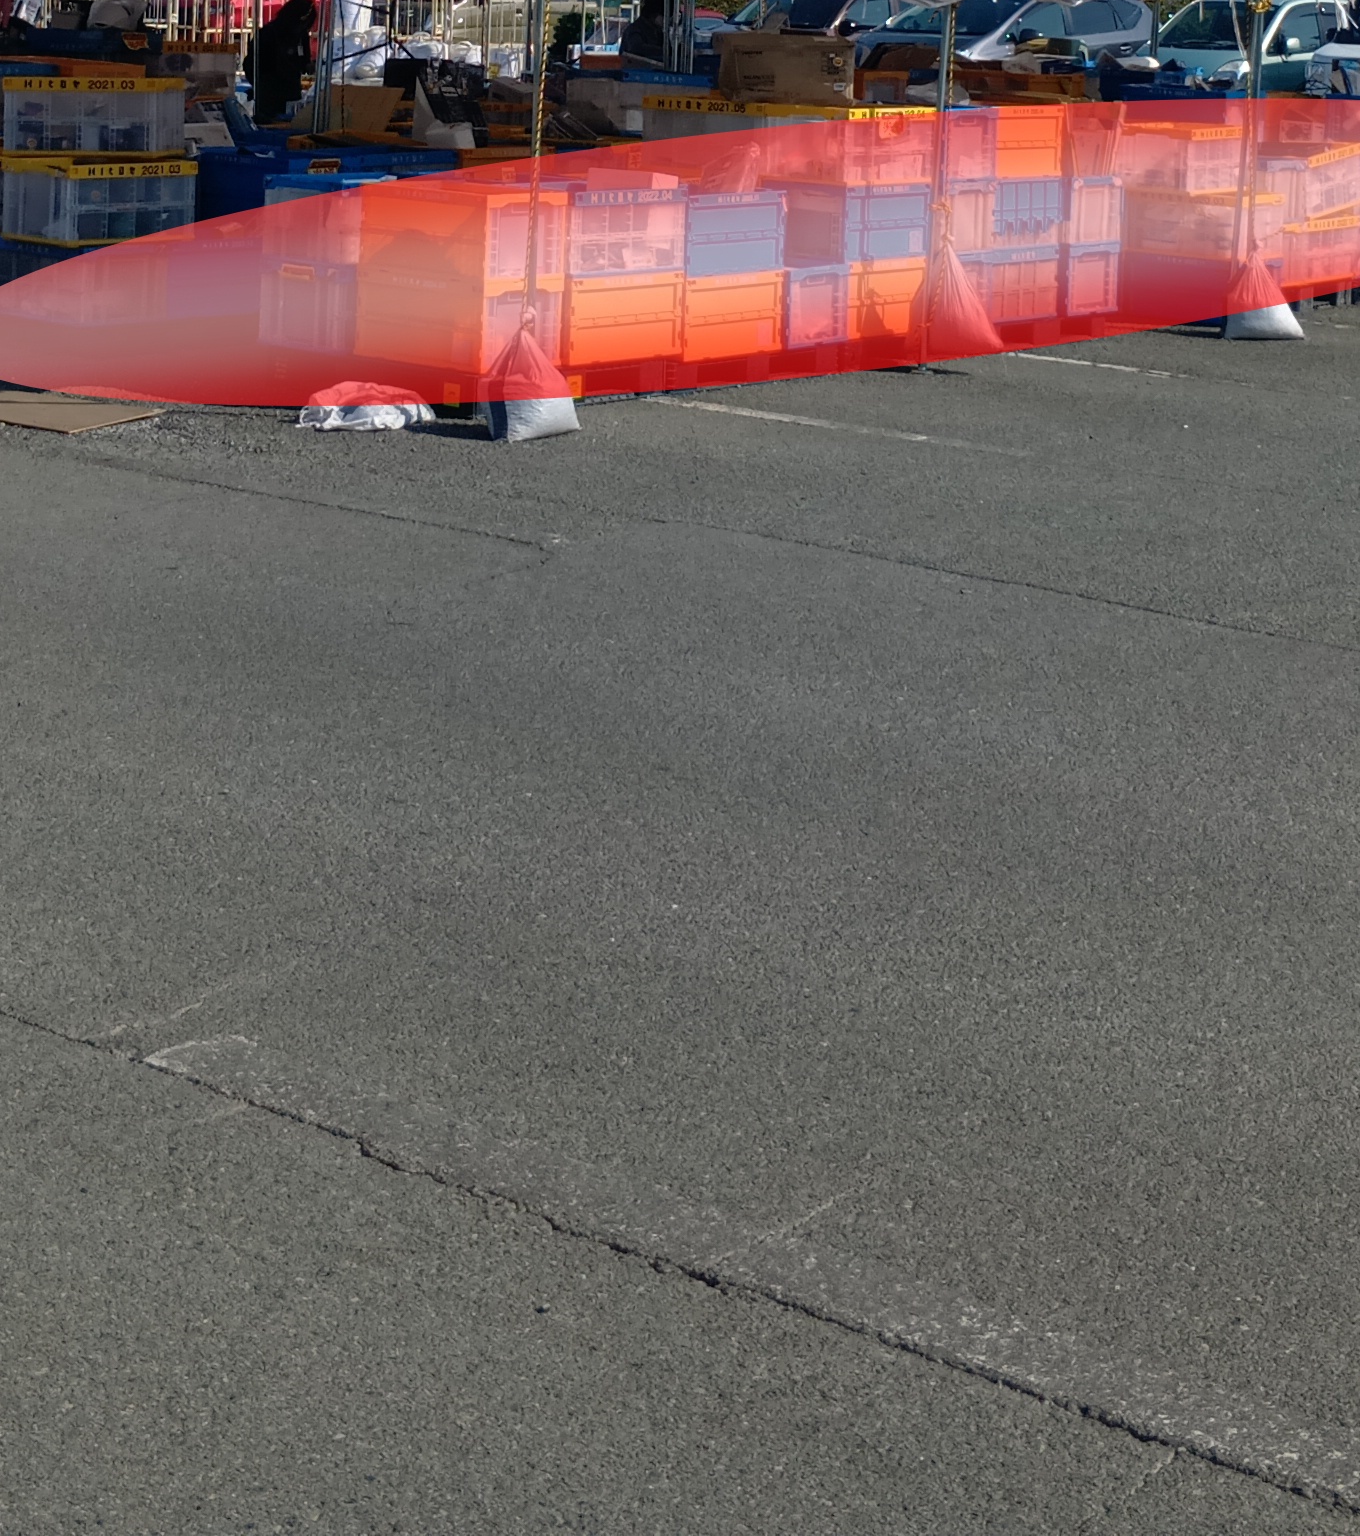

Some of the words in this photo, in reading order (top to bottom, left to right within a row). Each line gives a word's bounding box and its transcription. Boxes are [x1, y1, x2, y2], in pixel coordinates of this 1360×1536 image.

[87, 80, 135, 90] 2021.03
[707, 101, 746, 113] 2021.05
[637, 190, 673, 201] 2022.04
